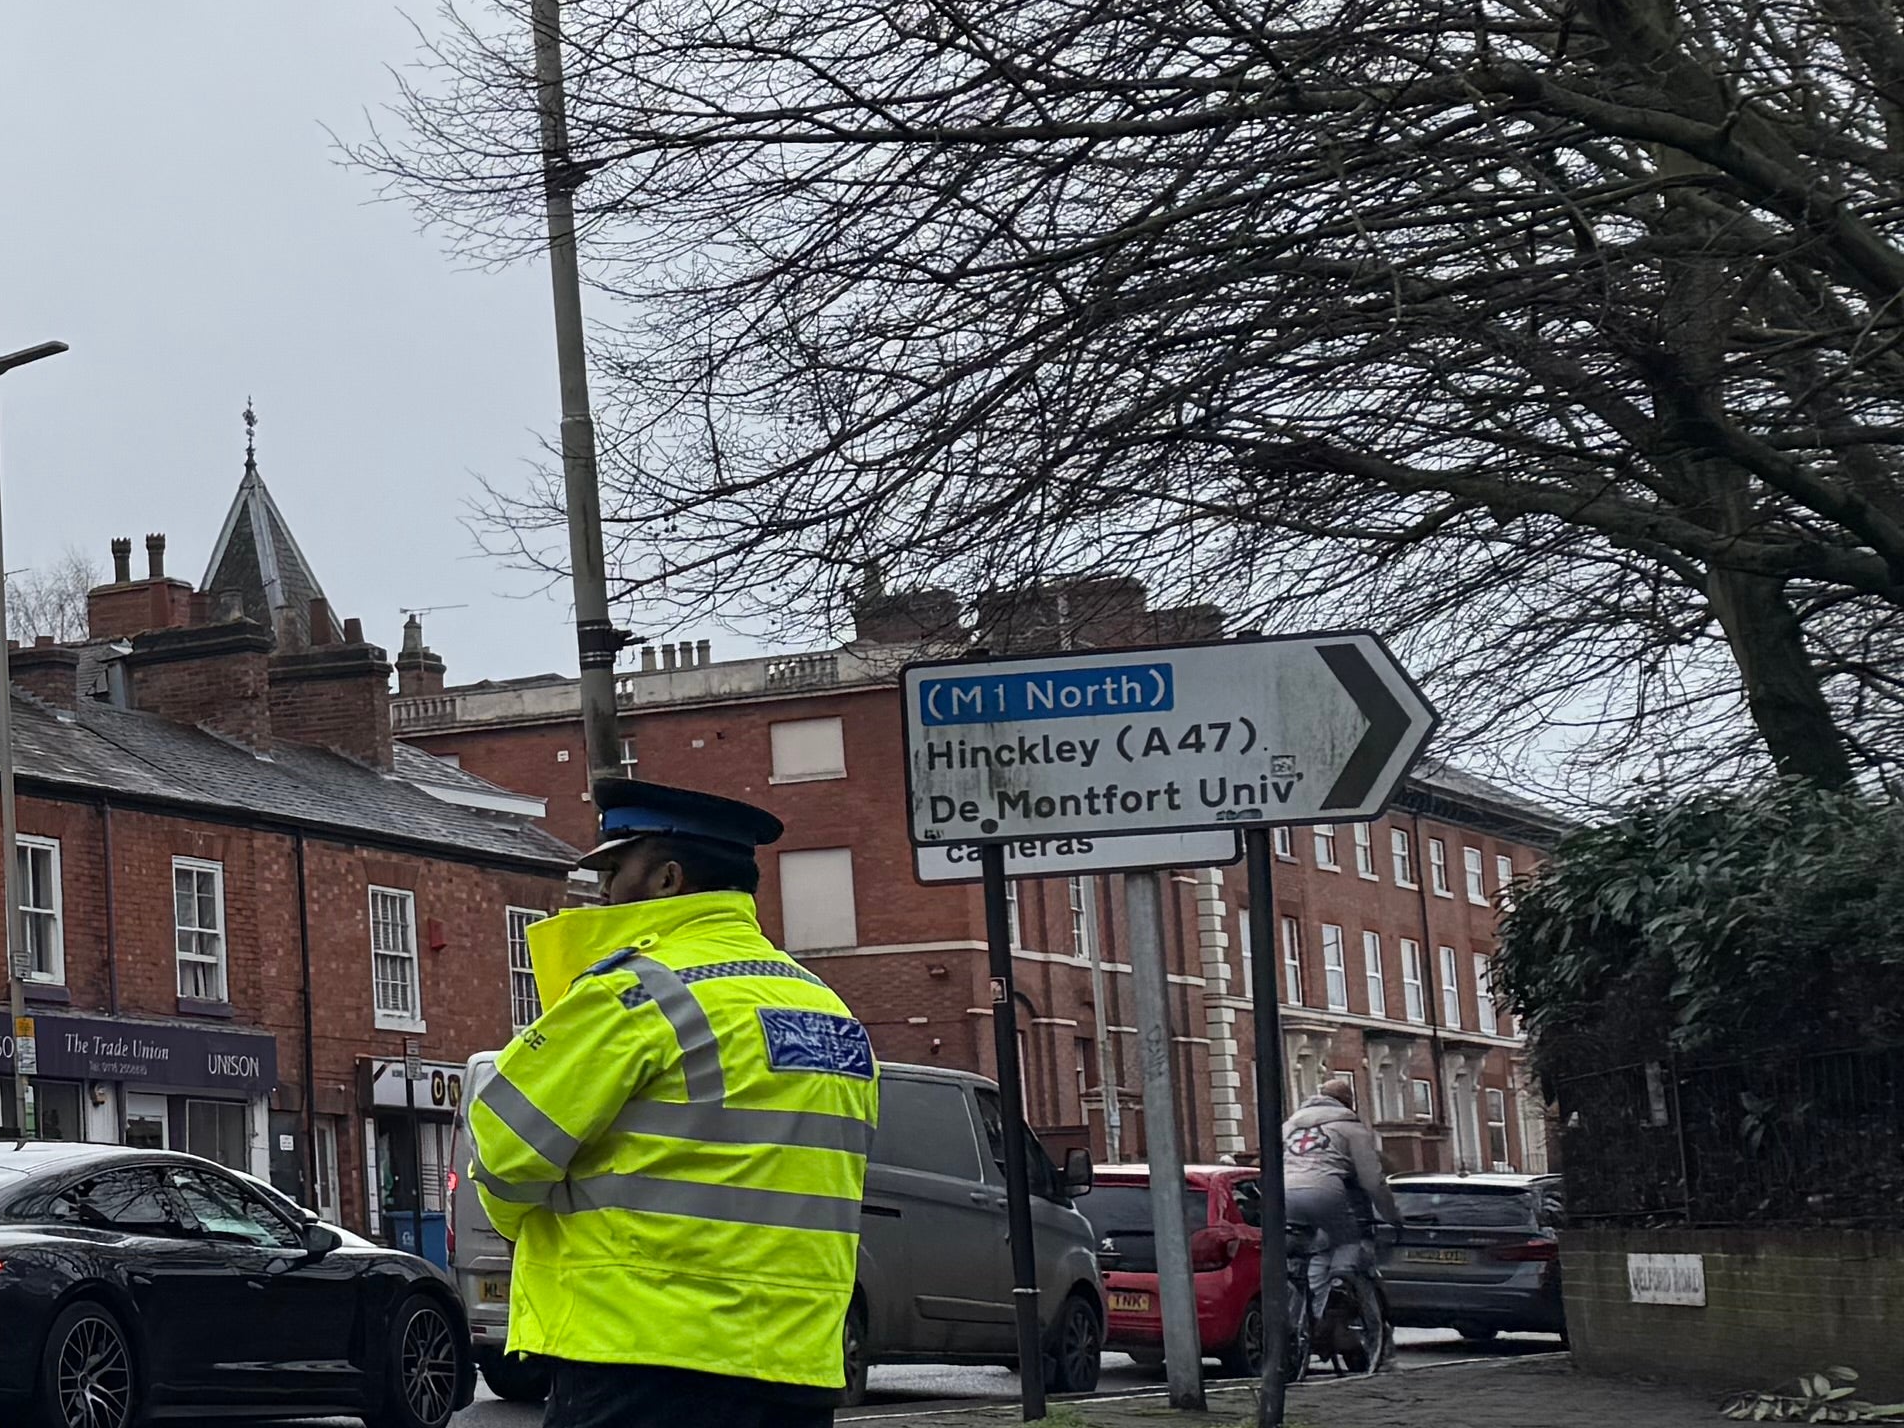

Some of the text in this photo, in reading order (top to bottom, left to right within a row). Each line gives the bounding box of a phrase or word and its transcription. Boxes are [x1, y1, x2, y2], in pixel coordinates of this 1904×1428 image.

[926, 667, 1167, 722] (M1 North)
[927, 716, 1258, 771] Hinckley (A47)
[929, 795, 981, 824] De
[997, 780, 1182, 820] Montfort
[65, 1033, 88, 1054] The
[93, 1036, 128, 1057] Trade
[133, 1039, 169, 1060] Union
[208, 1053, 260, 1078] UNISON
